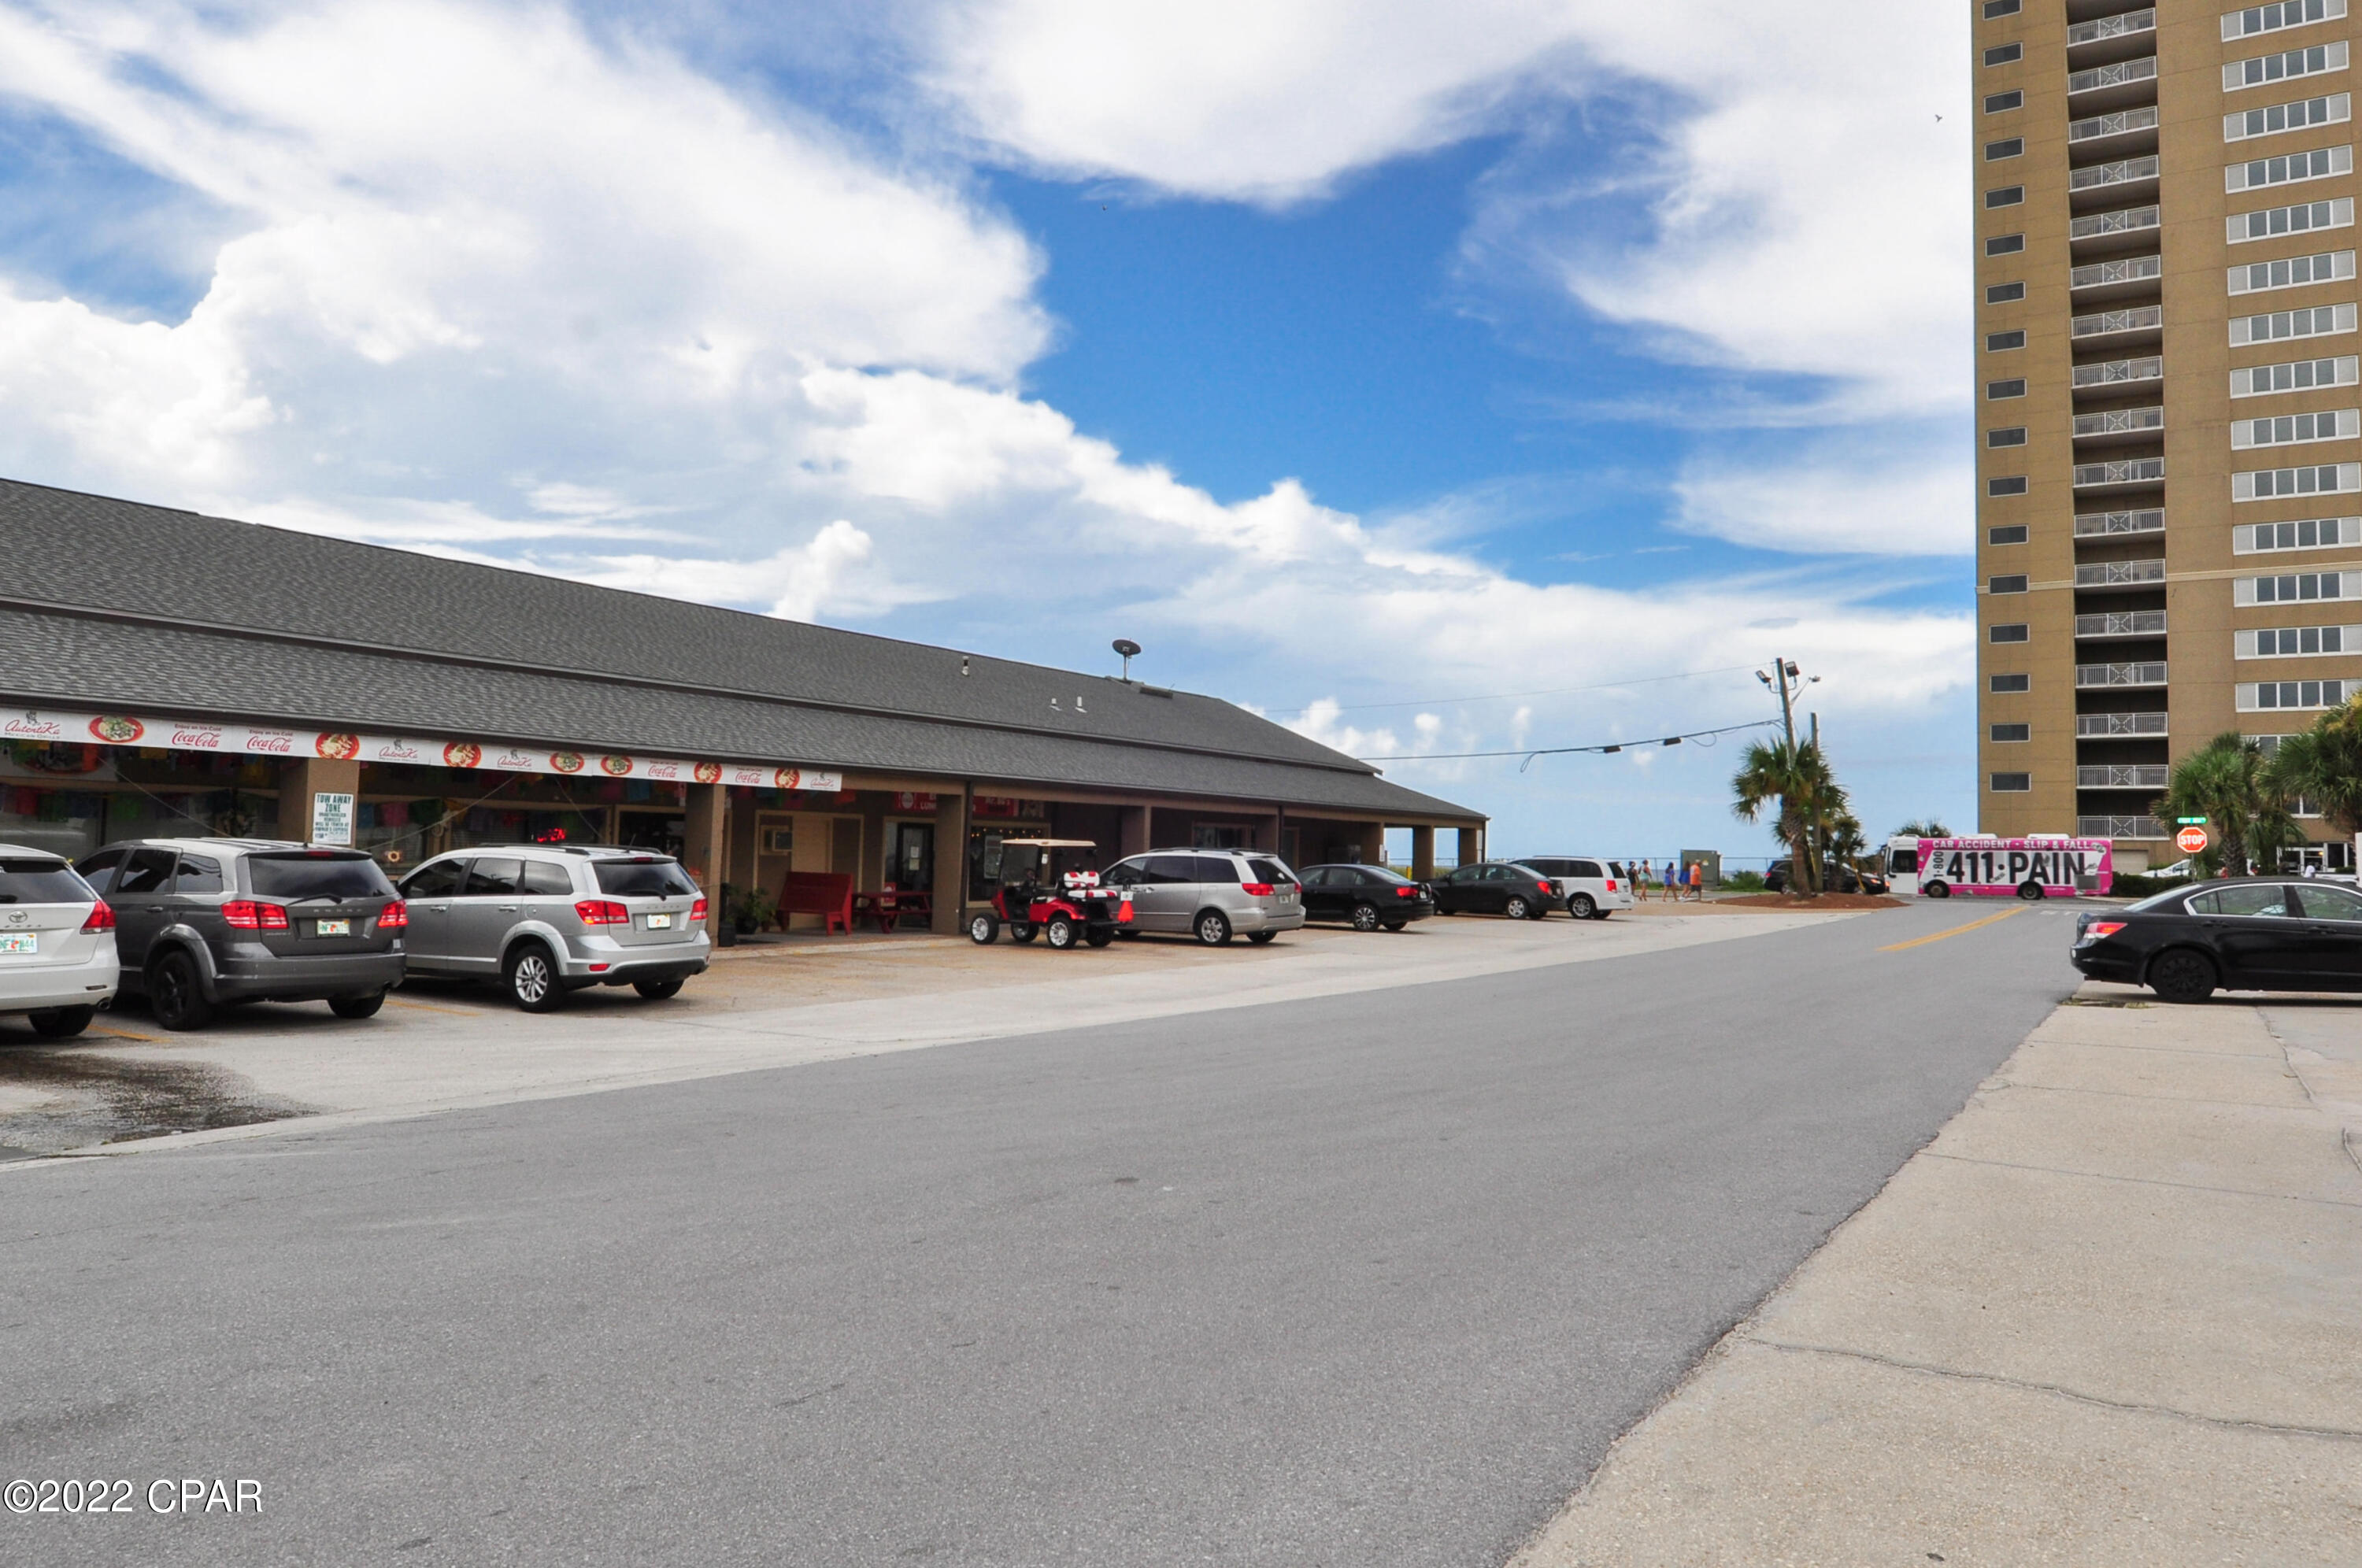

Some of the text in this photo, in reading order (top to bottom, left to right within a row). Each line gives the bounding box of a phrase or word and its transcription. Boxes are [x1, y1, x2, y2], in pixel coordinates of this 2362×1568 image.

[317, 794, 352, 804] TOW AWAY
[325, 804, 341, 812] ZONE
[2180, 834, 2205, 845] STOP
[1932, 840, 2090, 849] CAR ACCIDENT SLIP & FALL
